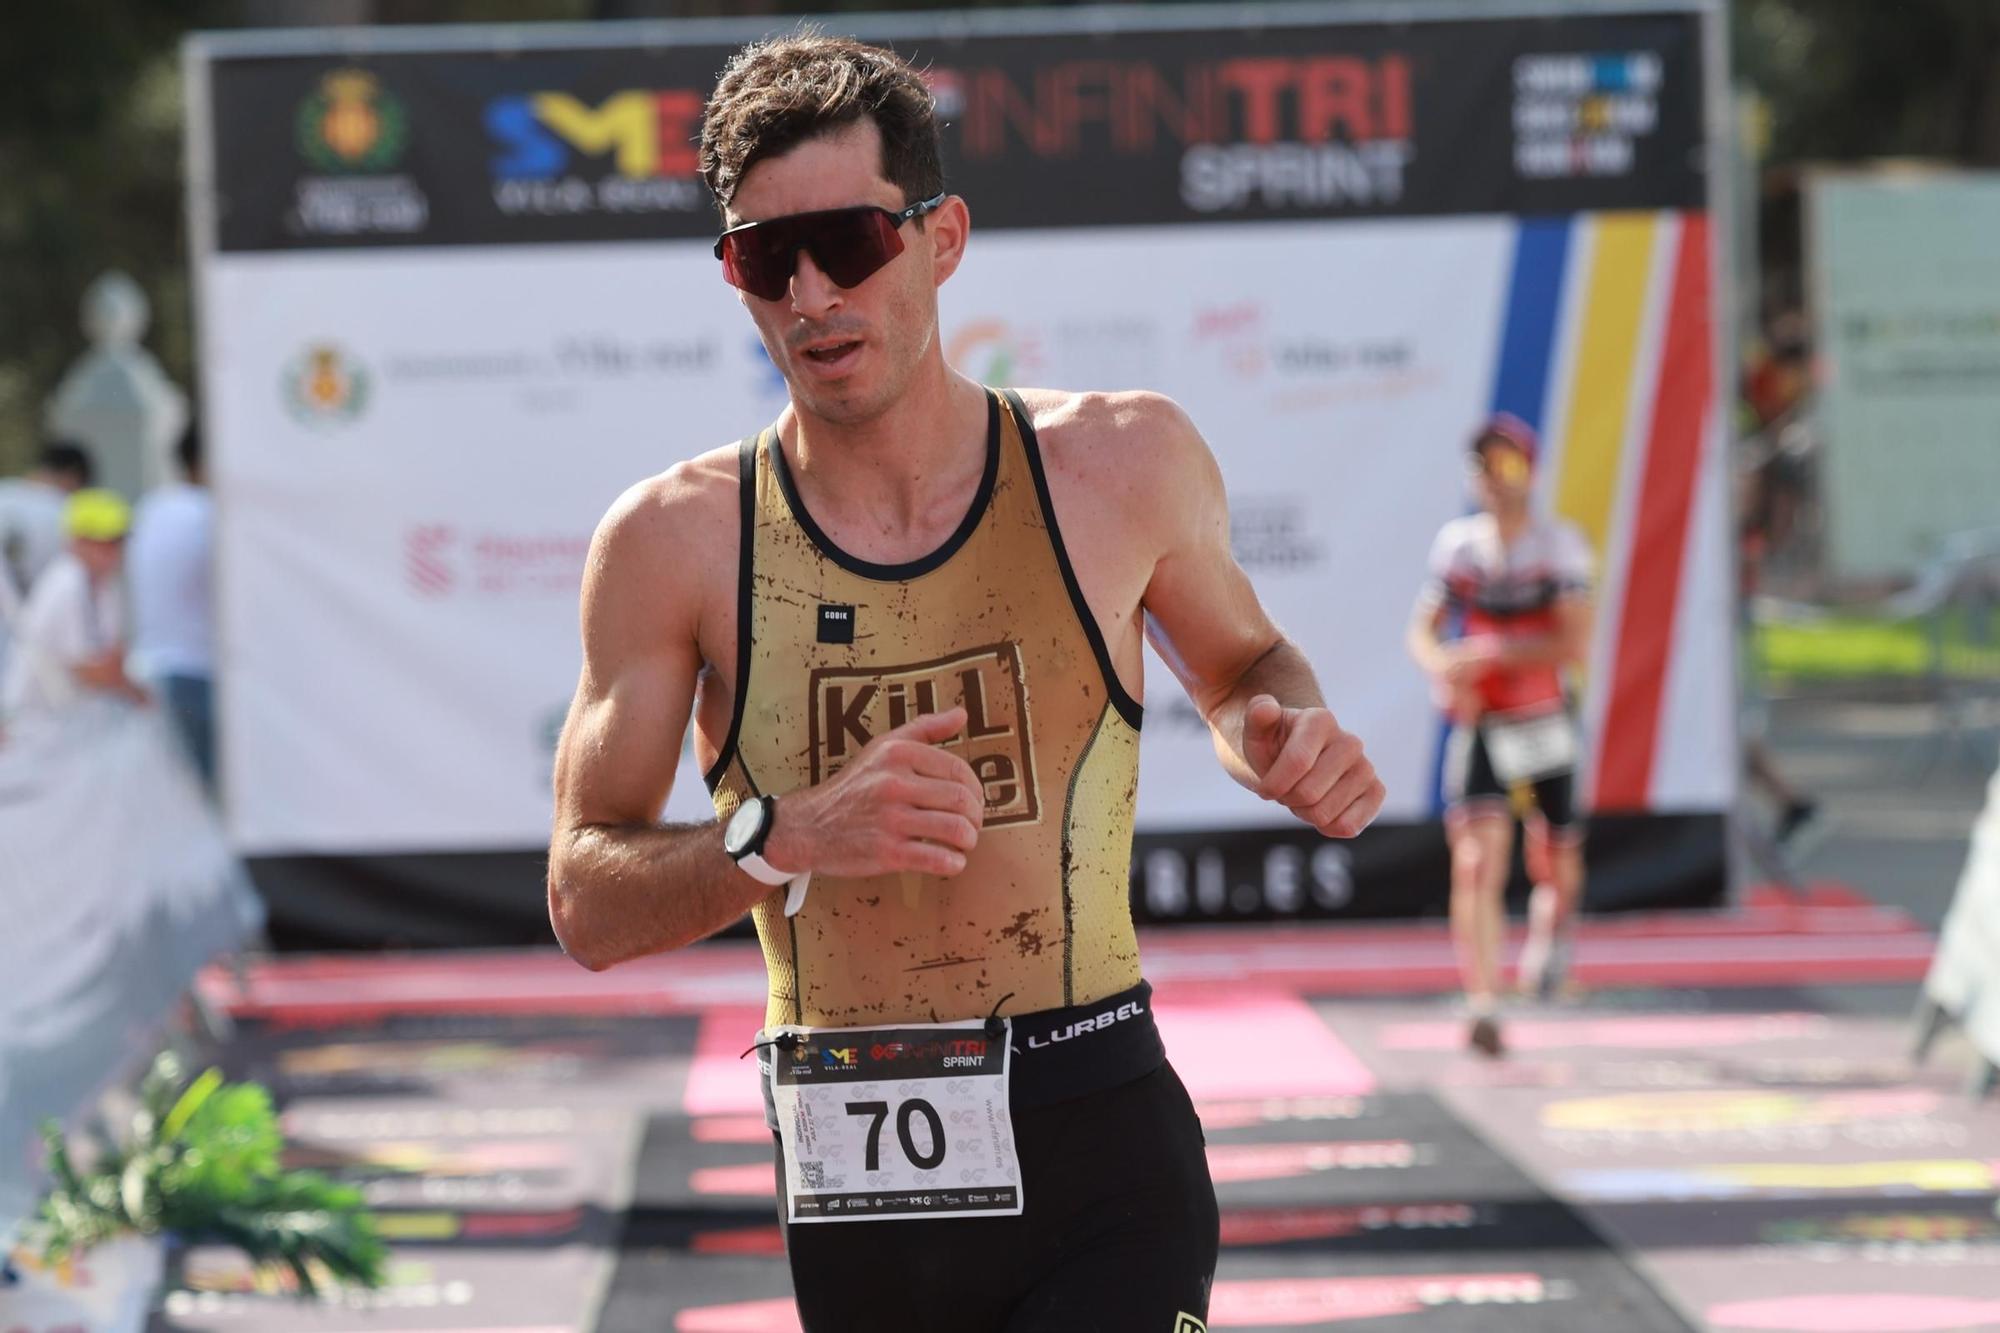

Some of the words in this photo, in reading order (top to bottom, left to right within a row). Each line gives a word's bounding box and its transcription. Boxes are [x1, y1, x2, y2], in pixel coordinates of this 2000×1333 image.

[488, 90, 699, 178] SME
[1181, 138, 1412, 209] SPRINT
[825, 611, 848, 620] GOBIK
[1028, 1001, 1144, 1049] LURBEL
[822, 1047, 858, 1065] SME
[943, 1056, 984, 1068] SPRINT
[845, 1098, 947, 1172] 70
